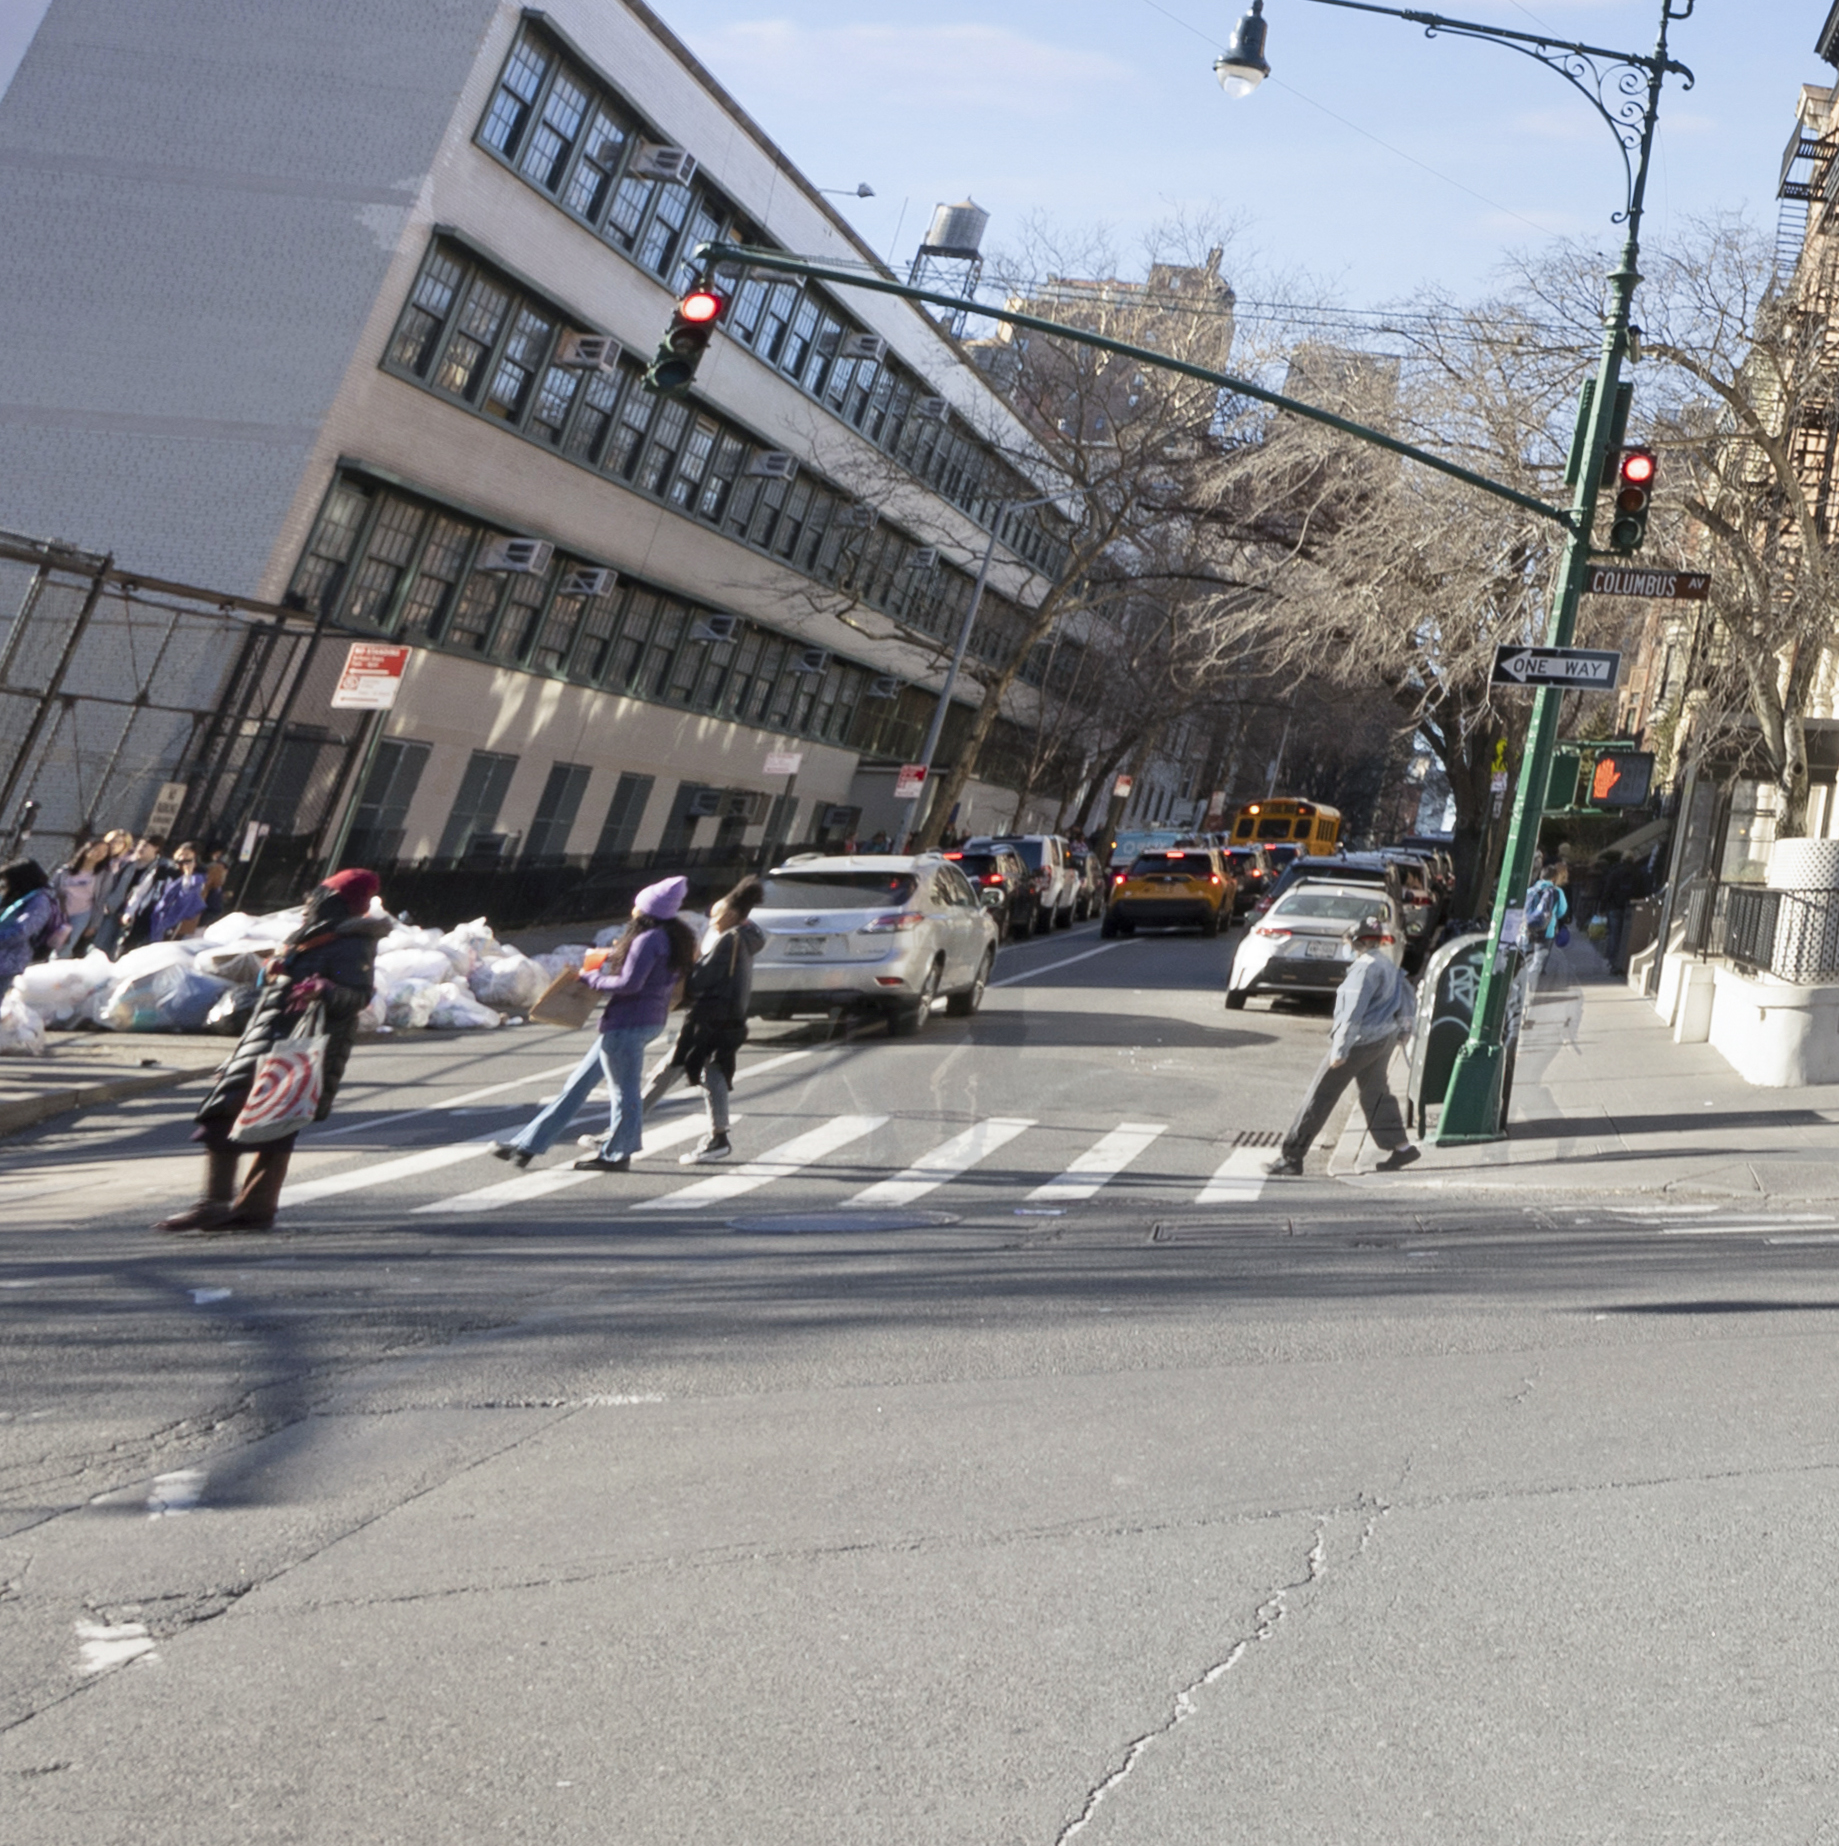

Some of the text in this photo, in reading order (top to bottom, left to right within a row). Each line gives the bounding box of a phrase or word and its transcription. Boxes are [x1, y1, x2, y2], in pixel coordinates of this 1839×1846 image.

[1592, 571, 1705, 597] COLUMBUS AV
[1513, 658, 1604, 676] ONE WAY
